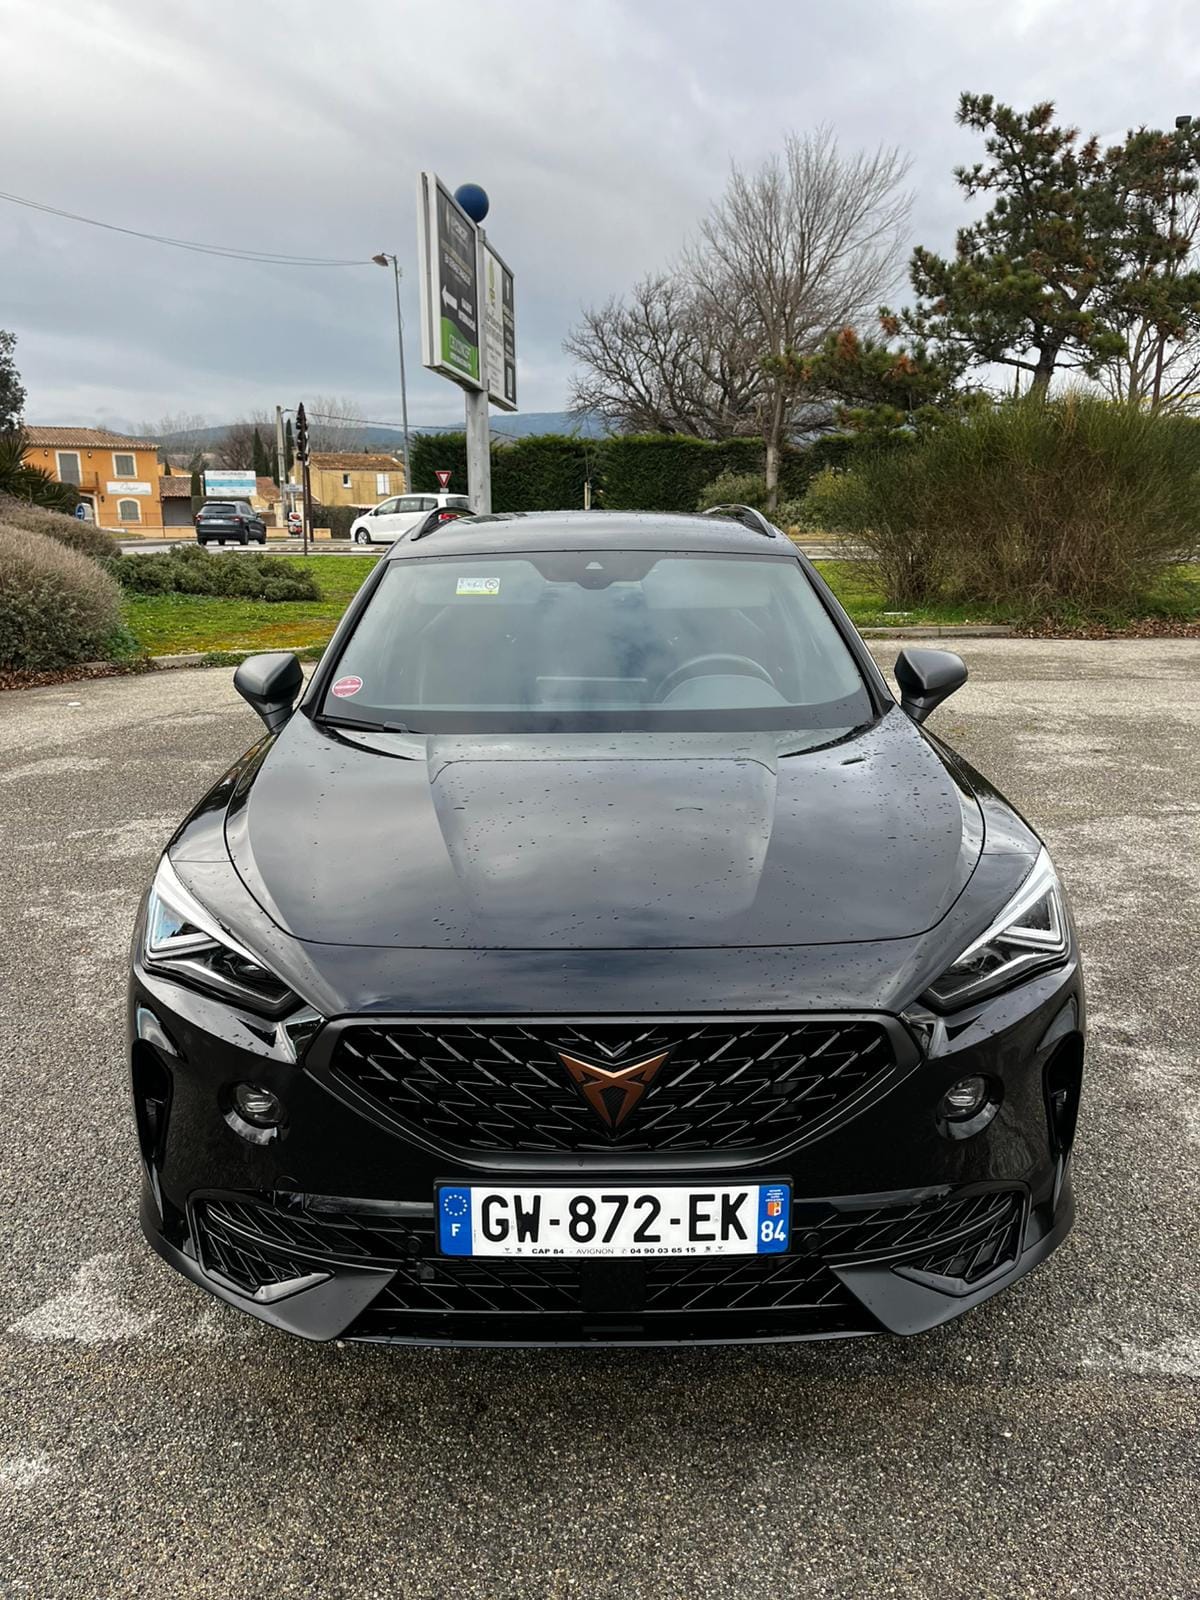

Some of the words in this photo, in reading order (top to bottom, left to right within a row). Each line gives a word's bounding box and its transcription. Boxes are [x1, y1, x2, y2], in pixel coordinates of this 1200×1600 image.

[481, 1193, 748, 1243] GW-872-EK
[451, 1223, 461, 1237] F
[761, 1220, 786, 1242] 84
